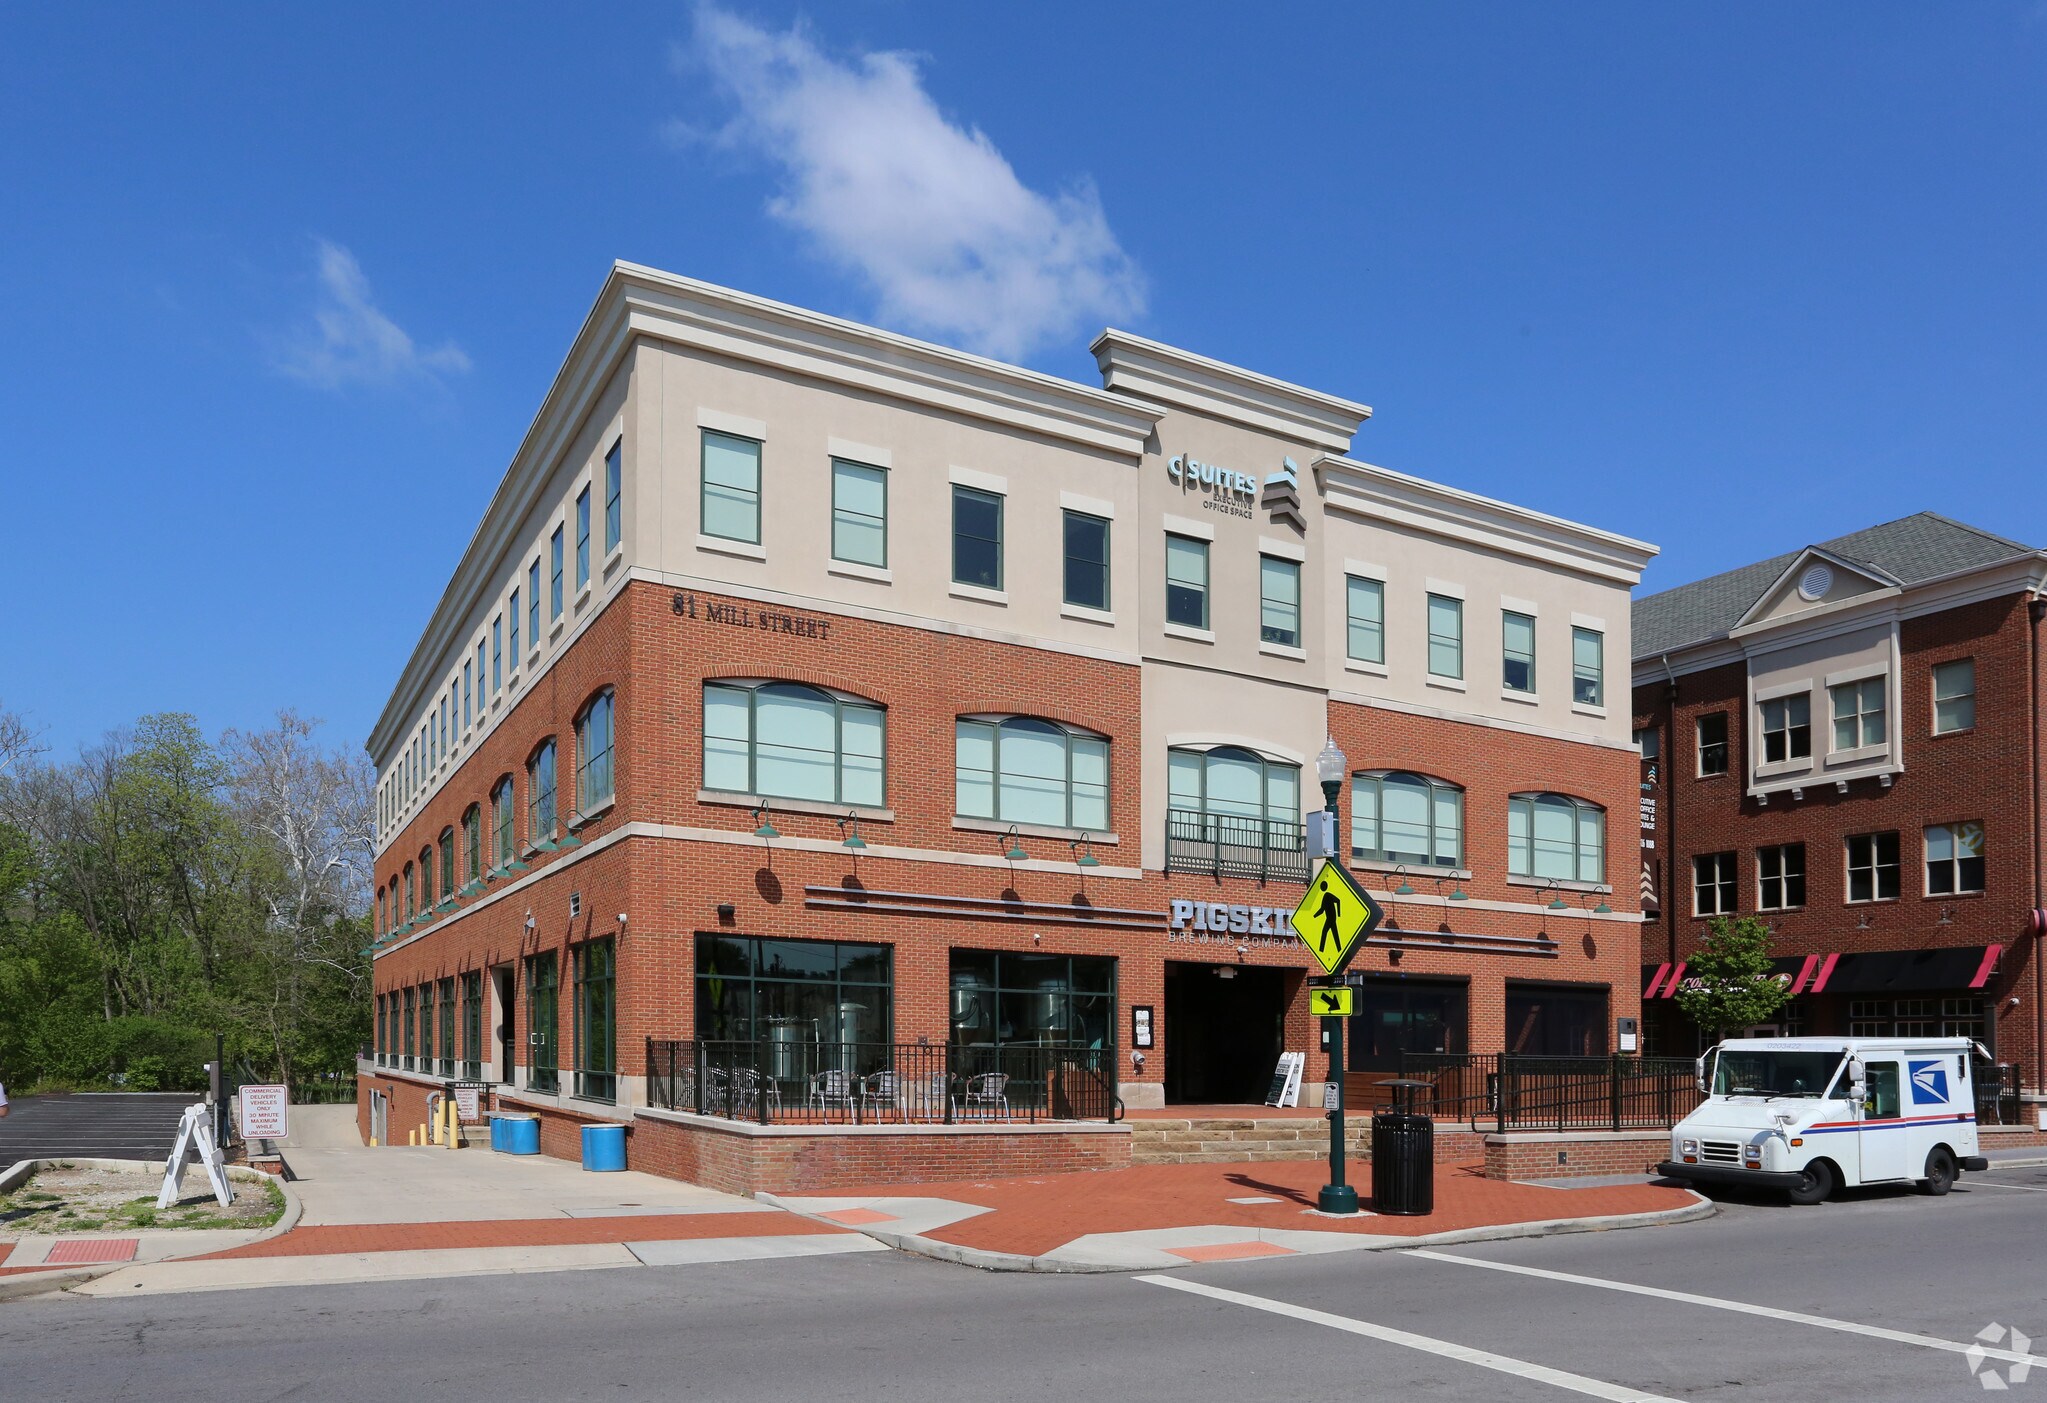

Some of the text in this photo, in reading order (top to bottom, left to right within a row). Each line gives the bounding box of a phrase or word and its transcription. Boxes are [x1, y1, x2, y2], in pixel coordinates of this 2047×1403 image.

[1203, 501, 1253, 519] OFFICE SPACE
[1213, 493, 1252, 510] EXECUTIVE
[672, 592, 830, 640] 81 MILL STREET
[1168, 931, 1306, 951] BREWING COMPANY
